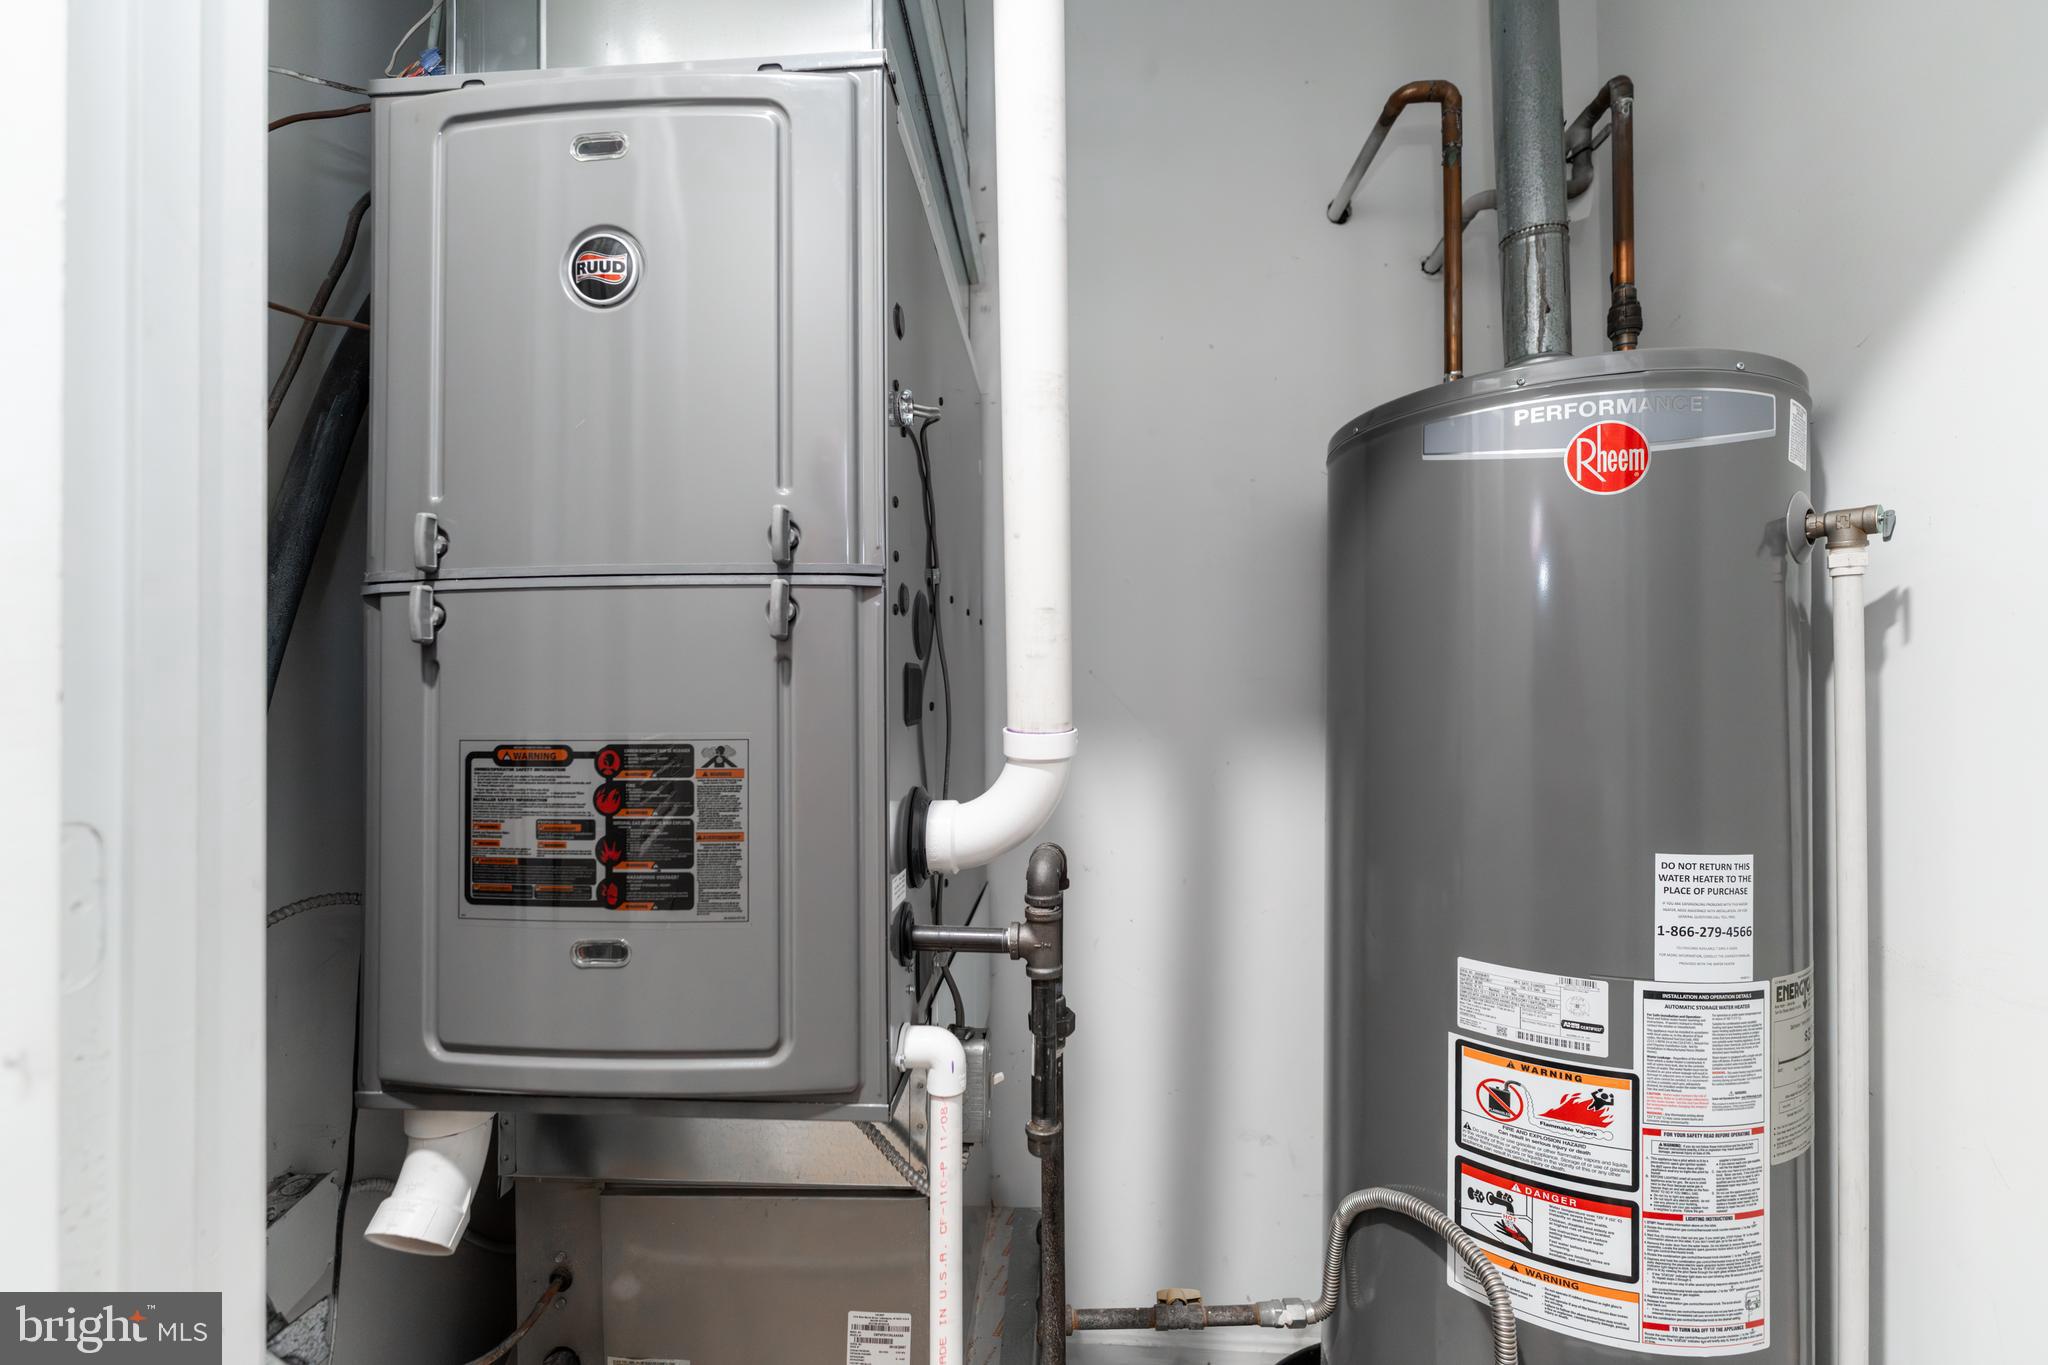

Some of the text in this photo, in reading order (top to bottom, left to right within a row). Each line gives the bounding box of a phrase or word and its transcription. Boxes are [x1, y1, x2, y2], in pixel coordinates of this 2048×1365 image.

[577, 260, 626, 275] RUUD
[1514, 396, 1703, 427] PERFORMANCE
[1576, 424, 1645, 483] Rheem
[513, 752, 556, 760] WARNING
[1661, 862, 1675, 870] DO
[1678, 862, 1697, 870] NOT
[1700, 863, 1732, 871] RETURN
[1659, 874, 1752, 883] WATER HEATER TO THE
[1663, 887, 1748, 895] PLACE OF PURCHASE
[1657, 925, 1752, 938] 1-866-279-4566
[1521, 1064, 1583, 1083] WARNING
[1540, 1121, 1597, 1136] Flammable Vapors
[1529, 1133, 1561, 1144] EXPLOSION
[1562, 1141, 1587, 1149] HAZARD
[1531, 1139, 1551, 1147] serious
[1525, 1187, 1577, 1207] DANGER
[1503, 1214, 1517, 1223] HOT
[939, 1244, 948, 1300] U.S.A.
[1525, 1268, 1579, 1290] WARNING
[939, 1309, 947, 1326] IN
[939, 1336, 947, 1365] ADE
